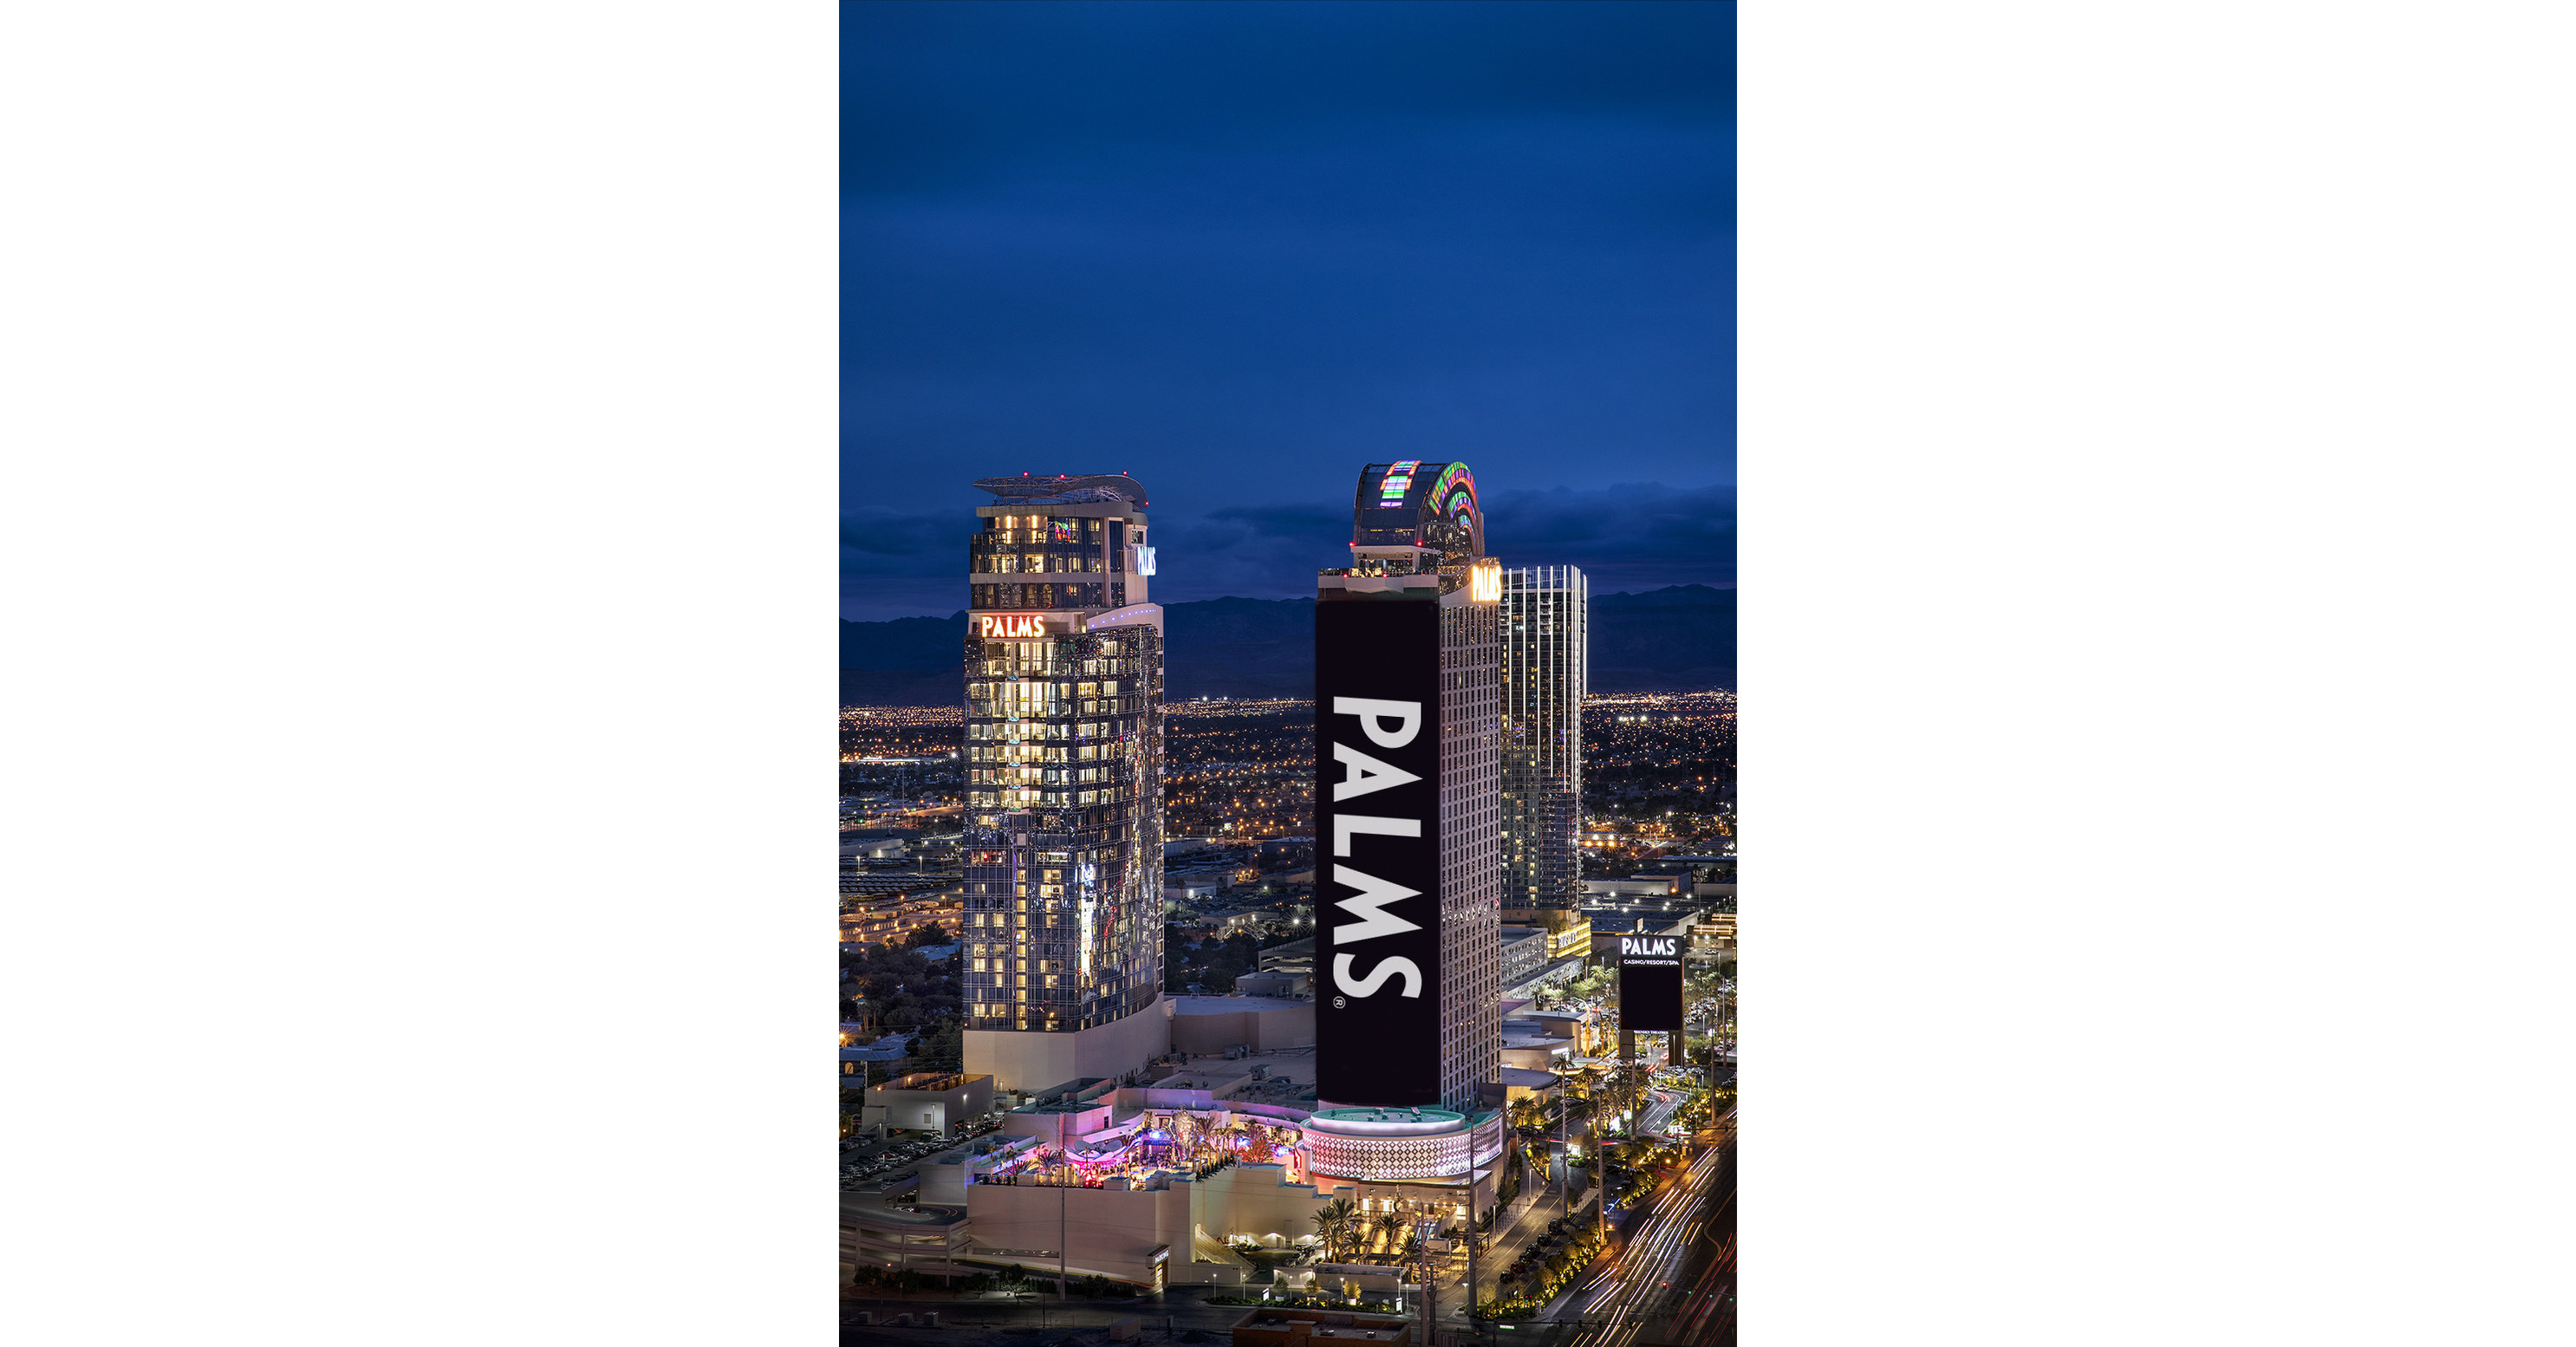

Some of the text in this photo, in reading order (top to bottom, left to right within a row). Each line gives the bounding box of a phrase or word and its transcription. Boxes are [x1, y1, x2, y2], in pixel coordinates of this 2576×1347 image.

[1473, 564, 1502, 602] PALMS
[981, 615, 1045, 638] PALMS
[1333, 696, 1423, 998] PALMS
[1622, 937, 1676, 956] PALMS
